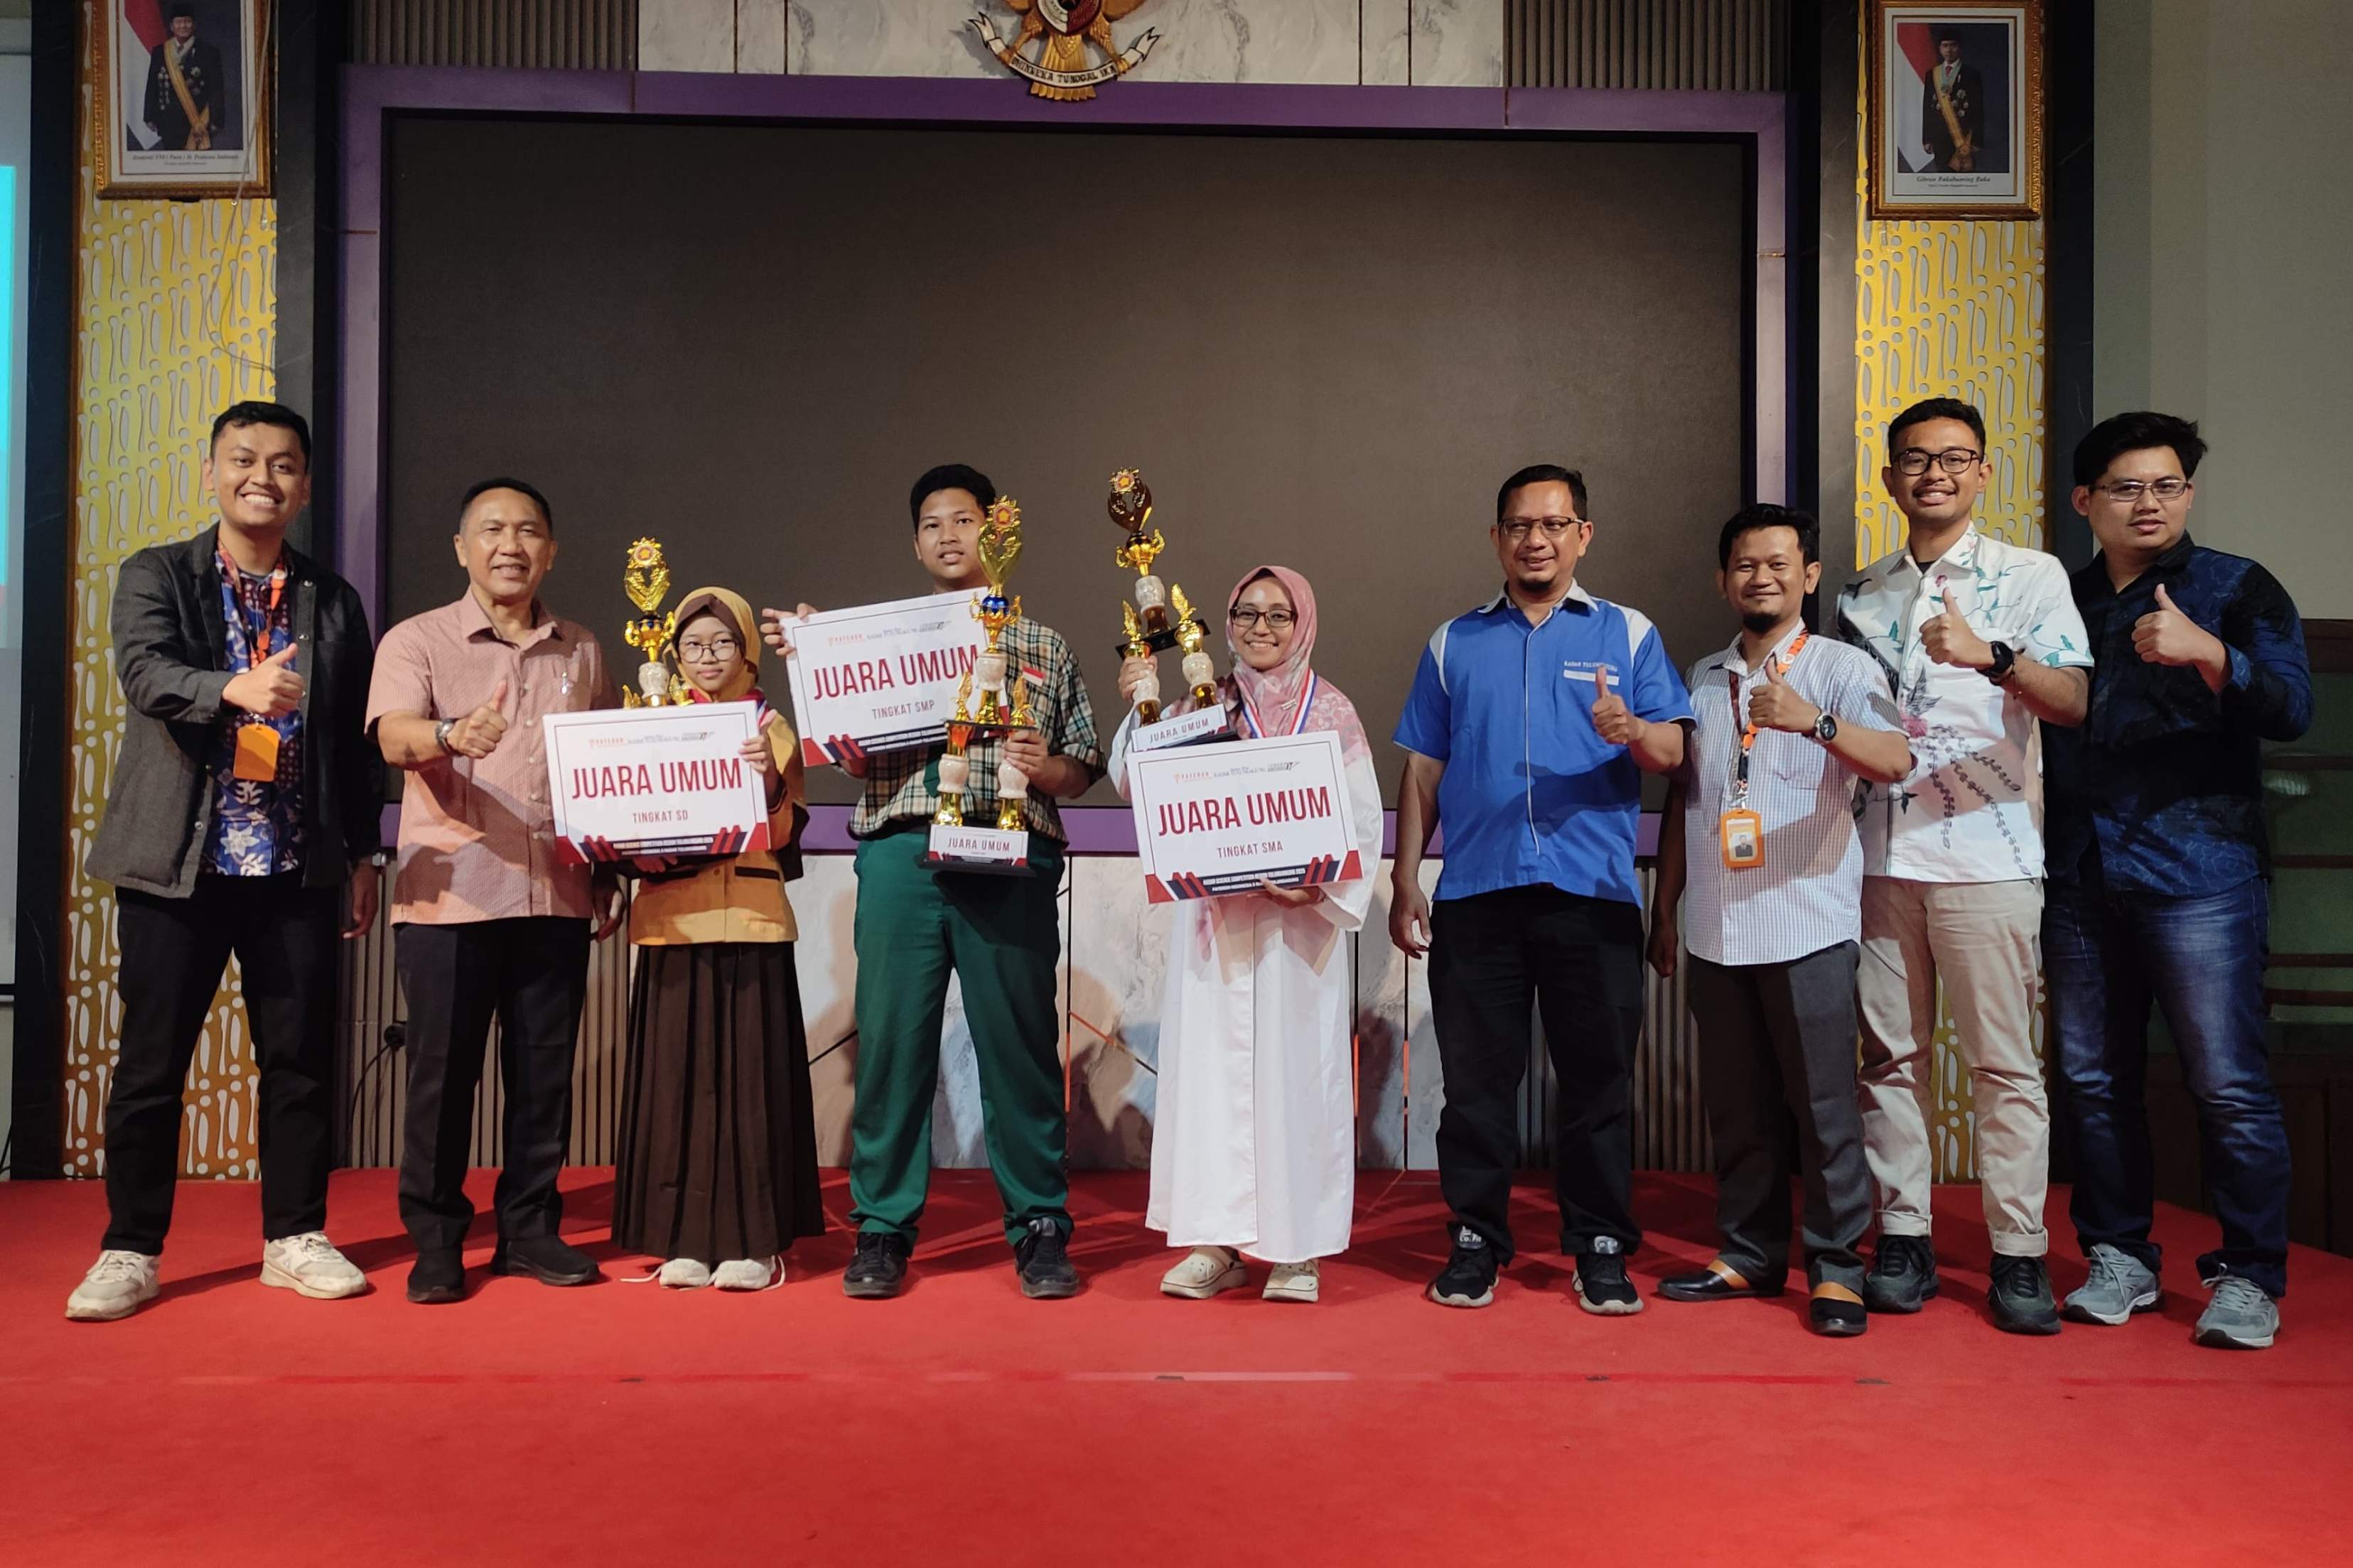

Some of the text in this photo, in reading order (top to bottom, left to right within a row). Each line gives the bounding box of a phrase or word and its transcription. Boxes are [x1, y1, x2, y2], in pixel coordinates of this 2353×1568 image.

[1057, 73, 1098, 84] TUNGGAL
[1101, 65, 1116, 77] IKA
[814, 644, 979, 701] JUARA UMUM
[871, 700, 935, 720] TINGKAT SMP
[1150, 728, 1178, 743] JUARA
[1181, 718, 1210, 733] UMUM
[571, 757, 742, 799] JUARA UMUM
[632, 809, 689, 824] TINGKAT SD
[1158, 786, 1332, 836] JUARA UMUM
[947, 837, 1011, 852] JUARA UMUM
[1217, 840, 1283, 859] TINGKAT SMA
